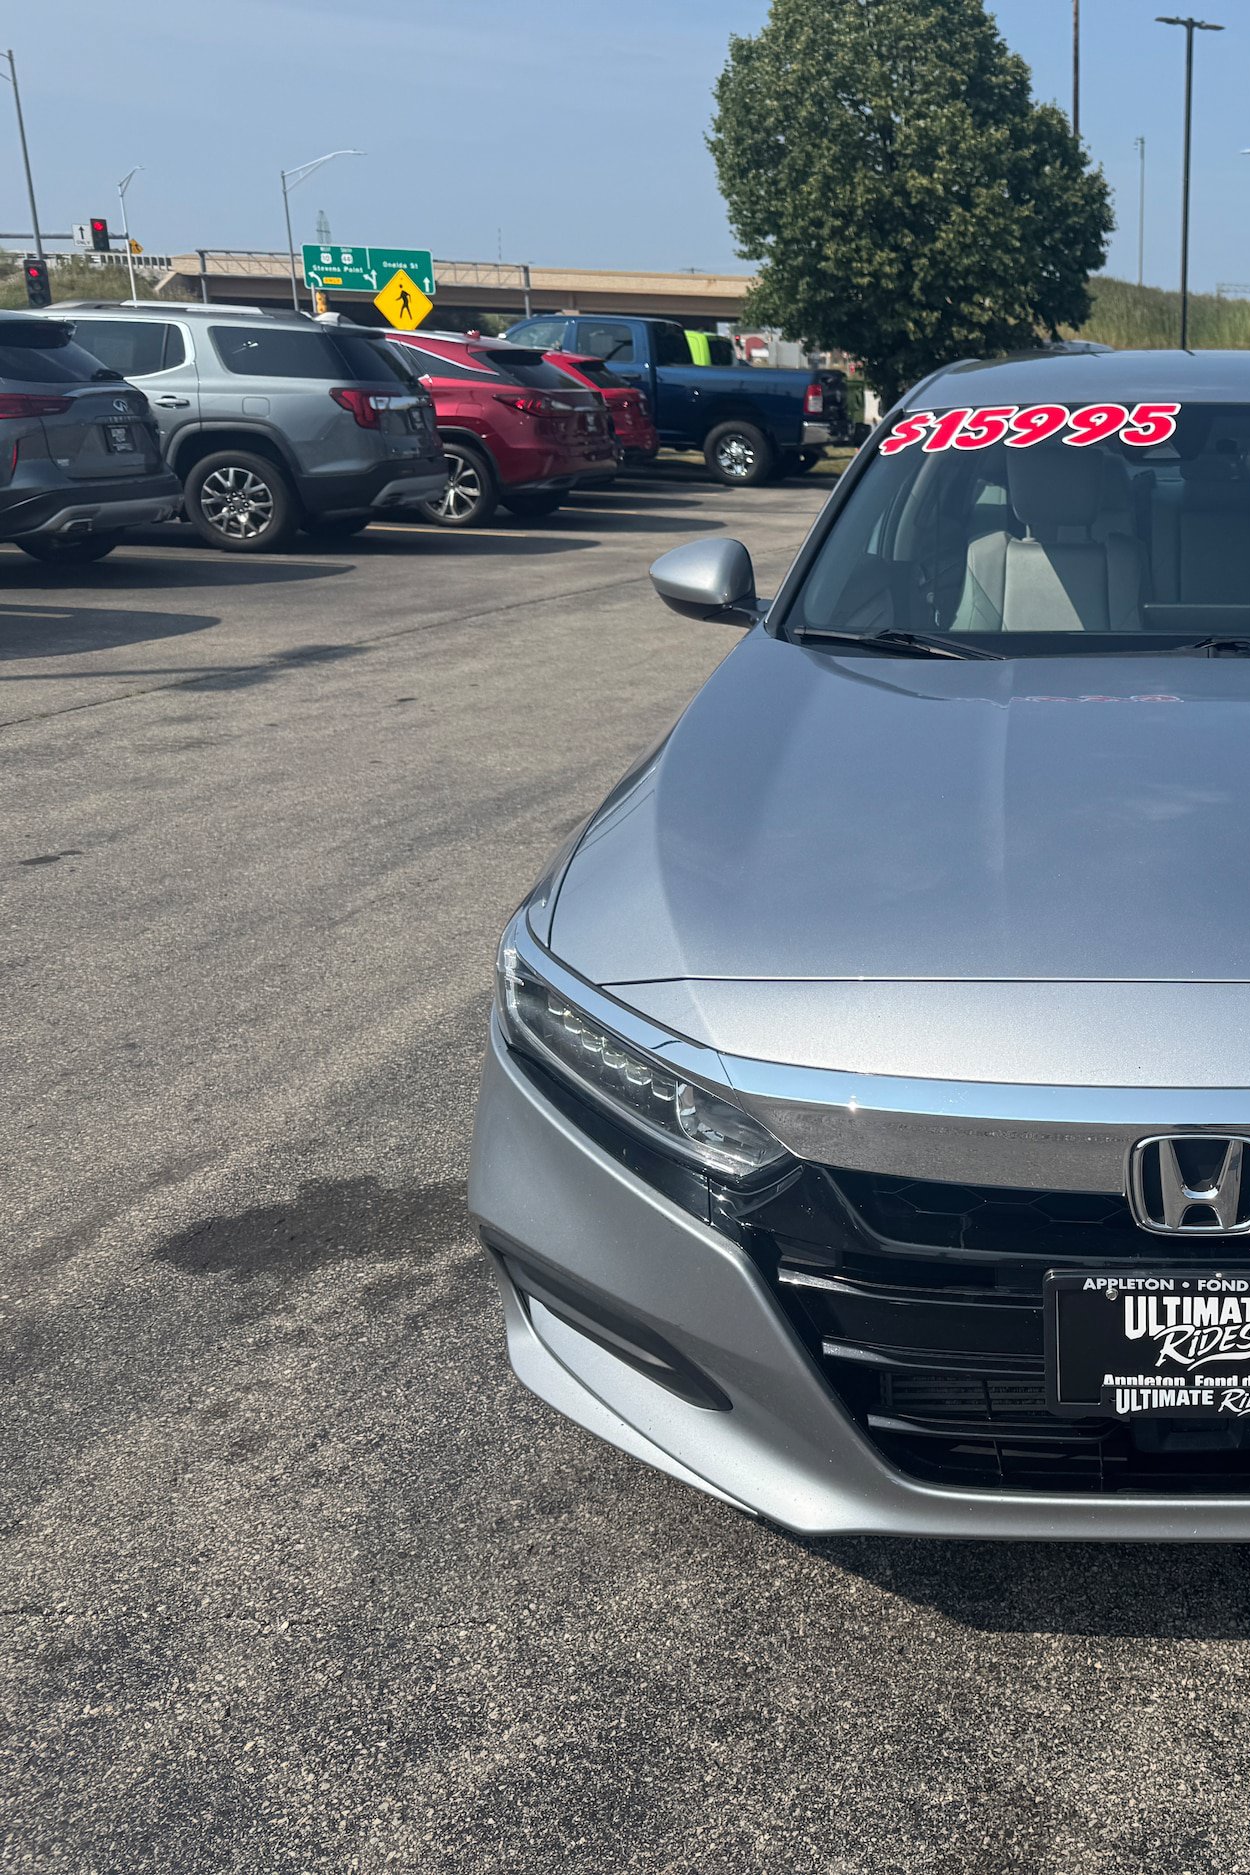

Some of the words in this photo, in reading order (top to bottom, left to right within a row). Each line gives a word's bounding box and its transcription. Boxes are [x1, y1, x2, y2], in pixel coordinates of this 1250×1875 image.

[312, 264, 341, 273] Stevens
[343, 266, 363, 274] Point
[879, 403, 1181, 456] $15995
[1083, 1278, 1174, 1291] APPLETON
[1198, 1279, 1249, 1292] FOND
[1195, 1374, 1238, 1387] Fond
[1115, 1389, 1214, 1414] ULTIMATE
